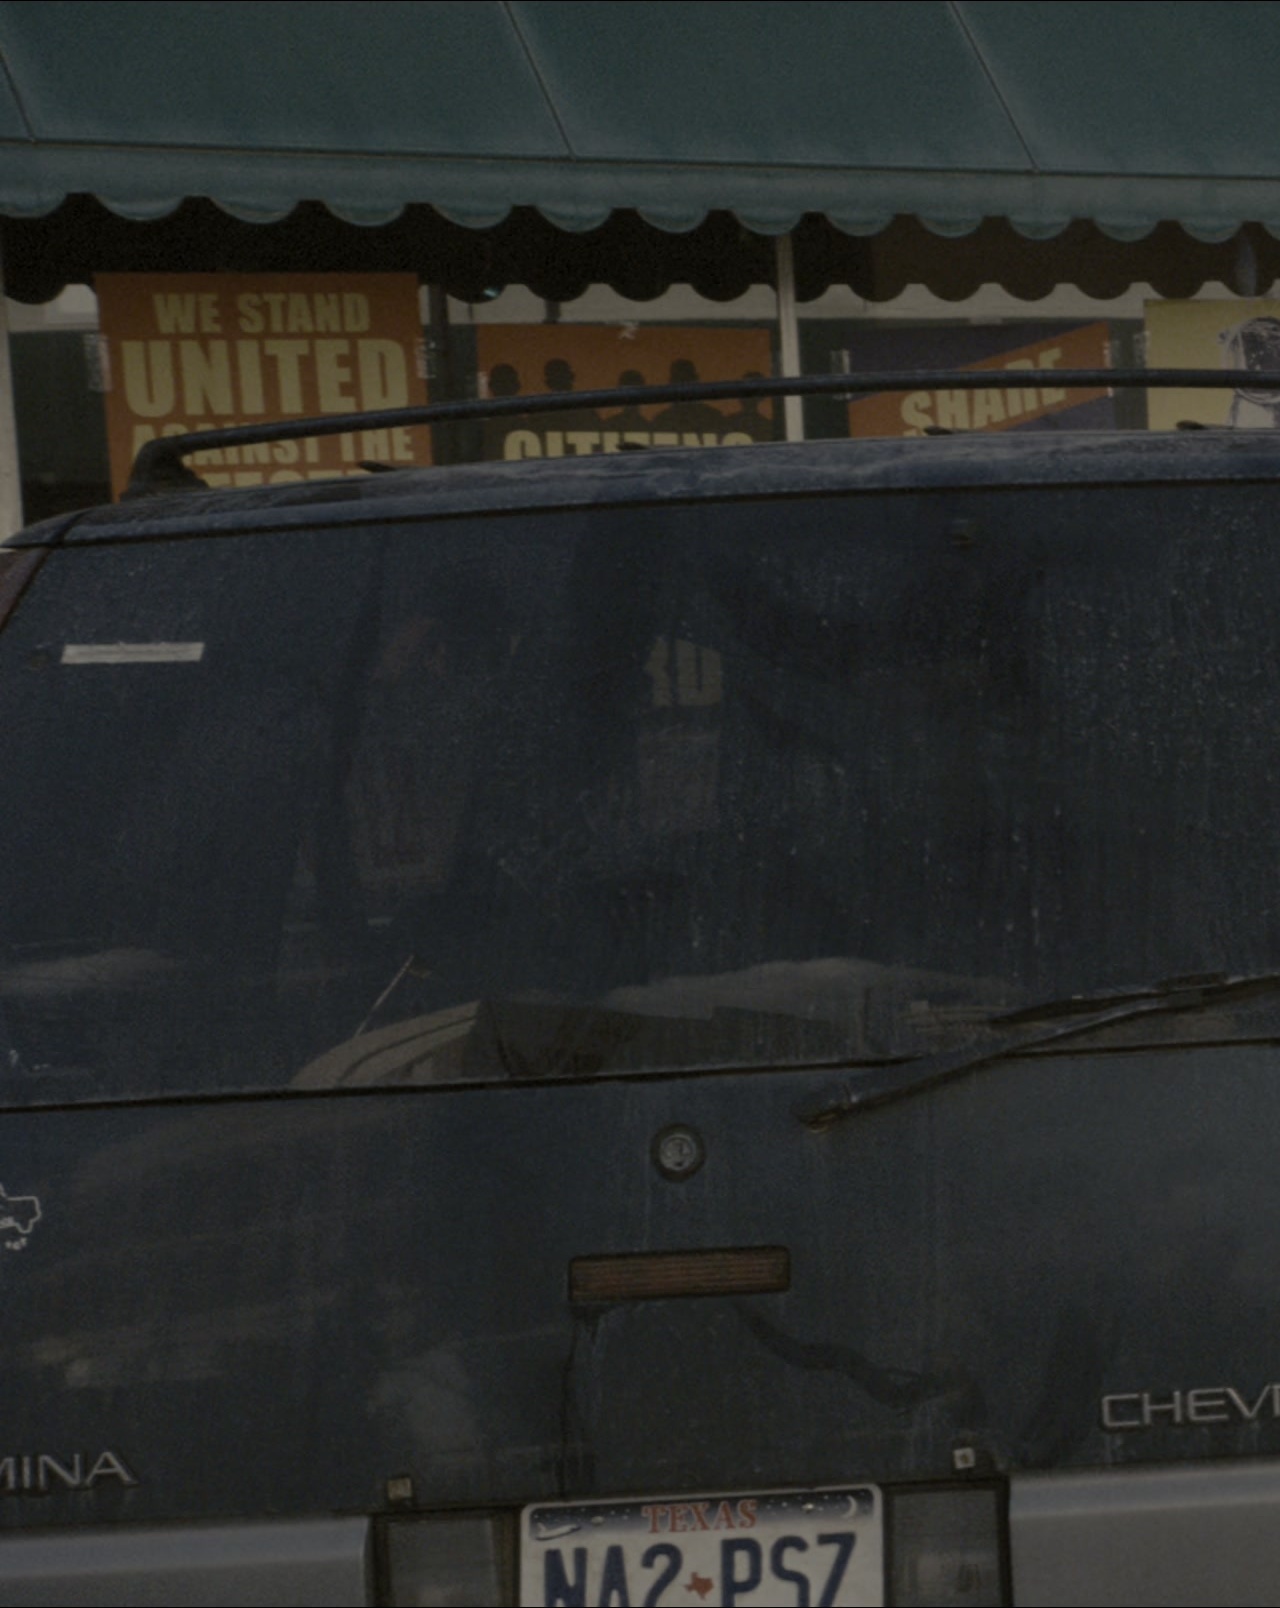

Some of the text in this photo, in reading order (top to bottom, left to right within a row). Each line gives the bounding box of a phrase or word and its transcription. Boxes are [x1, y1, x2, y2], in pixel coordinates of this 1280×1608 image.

[153, 293, 371, 334] WE STAND
[121, 338, 410, 418] UNITED
[901, 346, 1064, 431] SHARE
[337, 424, 416, 463] THE
[641, 1499, 758, 1533] TEXAS
[544, 1543, 683, 1607] NA2
